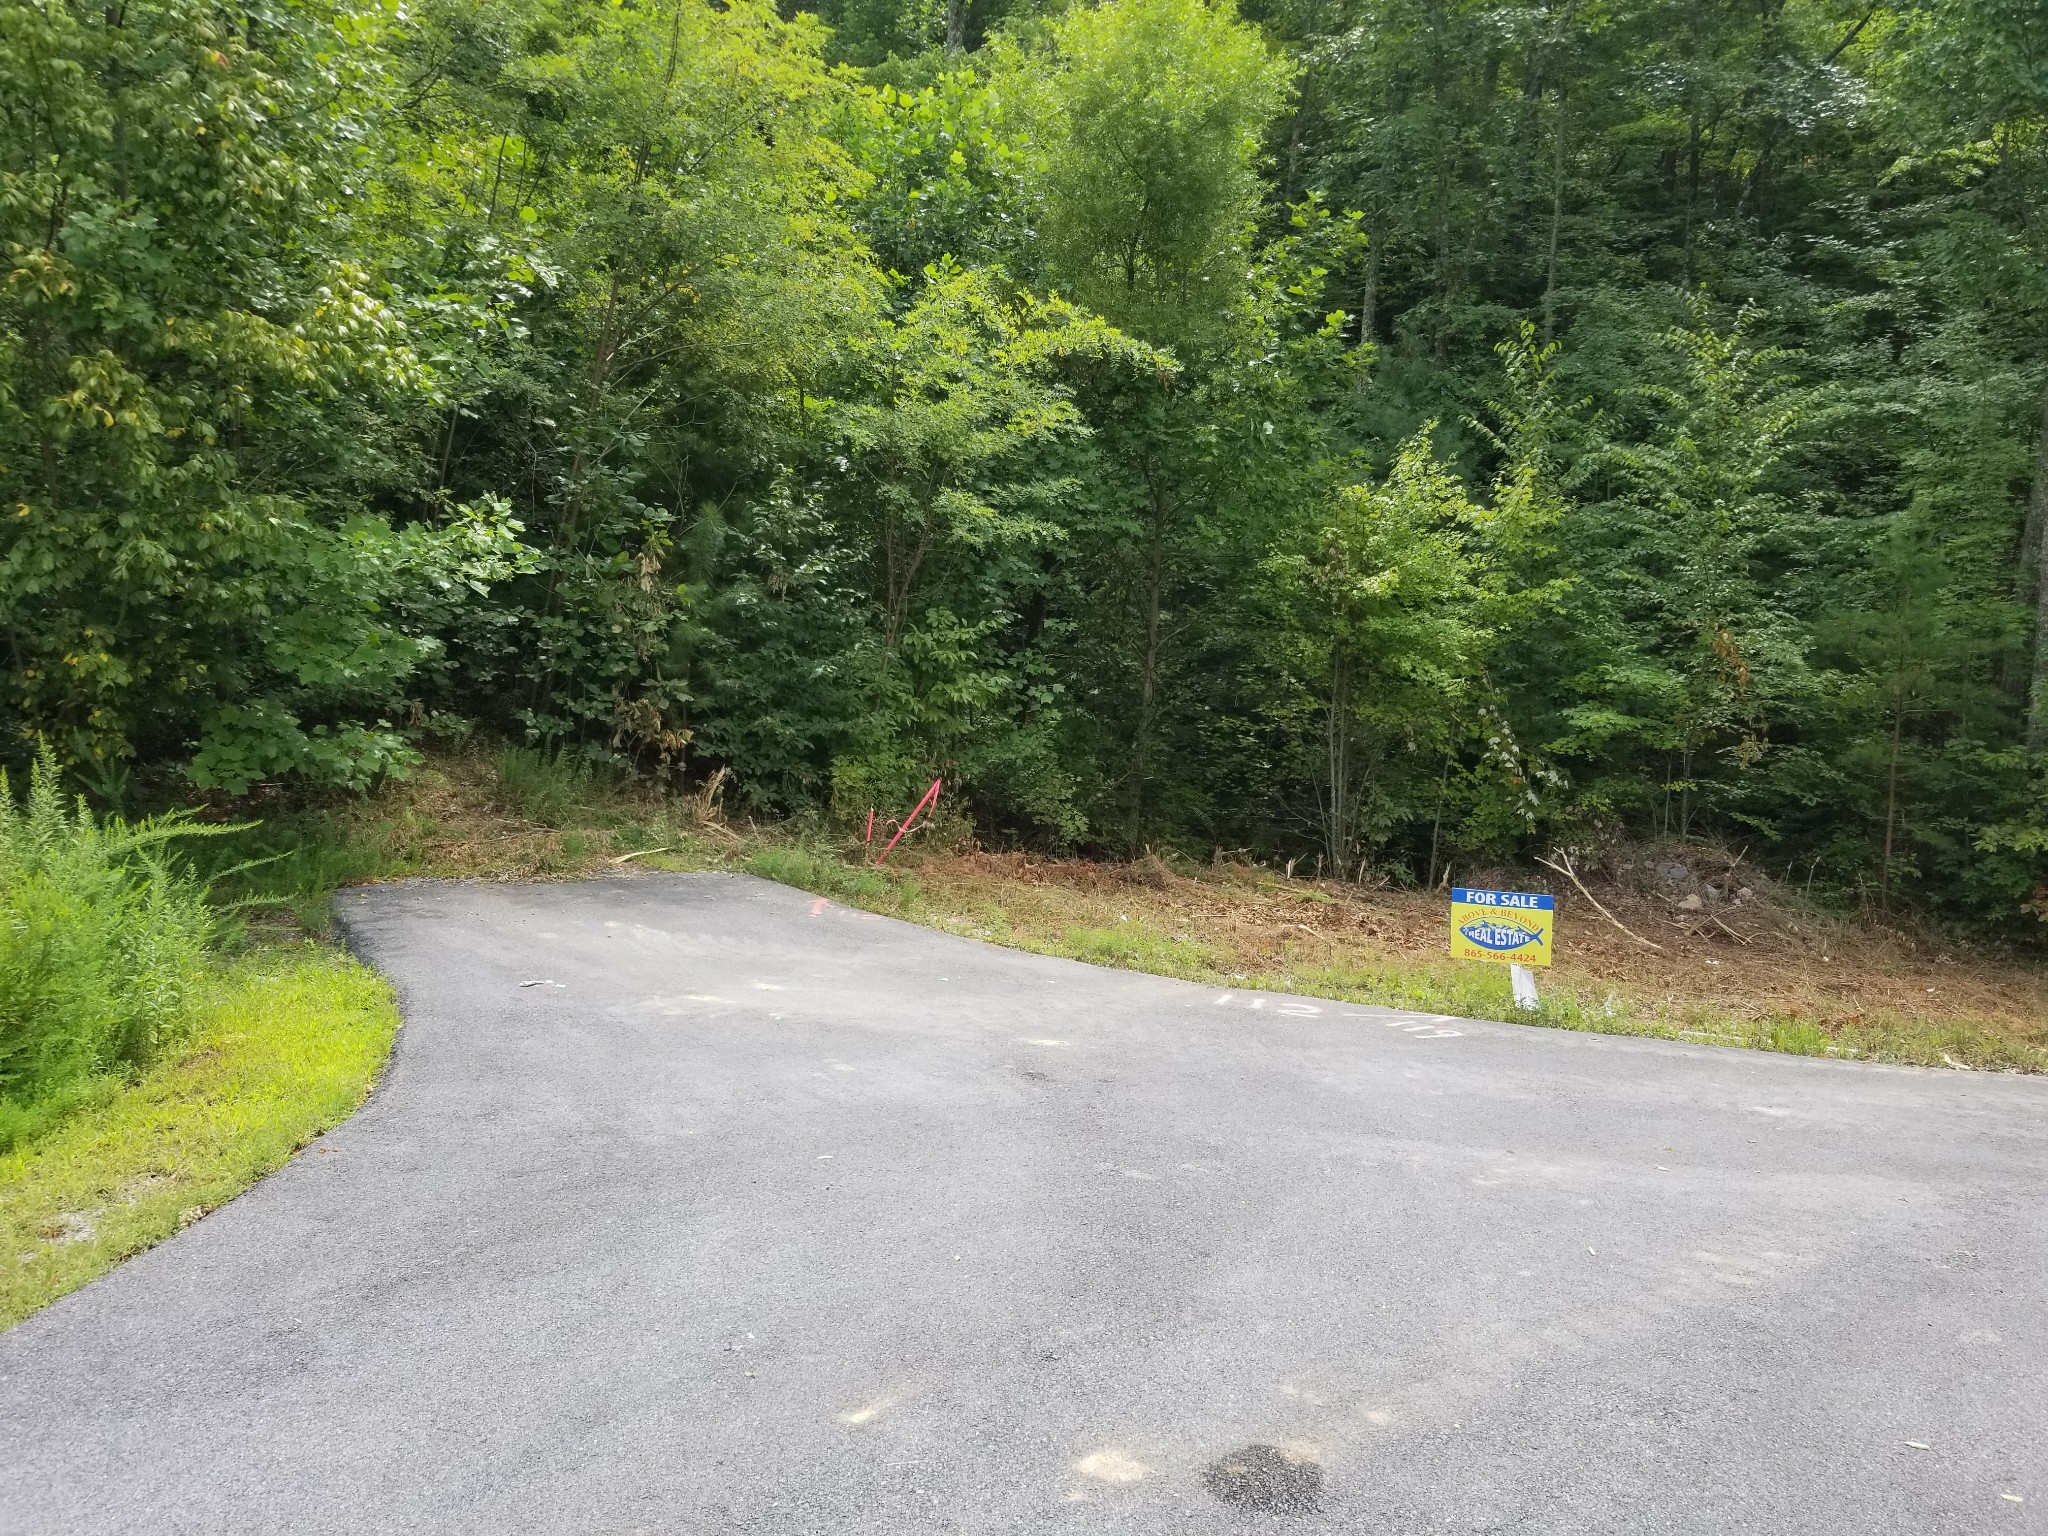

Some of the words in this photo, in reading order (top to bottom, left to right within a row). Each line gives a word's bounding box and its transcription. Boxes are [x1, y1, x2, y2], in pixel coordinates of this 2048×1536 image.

[1466, 891, 1496, 905] FOR
[1500, 894, 1538, 908] SALE
[1458, 908, 1487, 926] ABOVE
[1500, 909, 1539, 931] BEYOND
[1468, 927, 1492, 944] REAL
[1494, 928, 1531, 946] ESTATE
[1464, 948, 1537, 963] 865-566-4424
[1213, 994, 1322, 1018] 112
